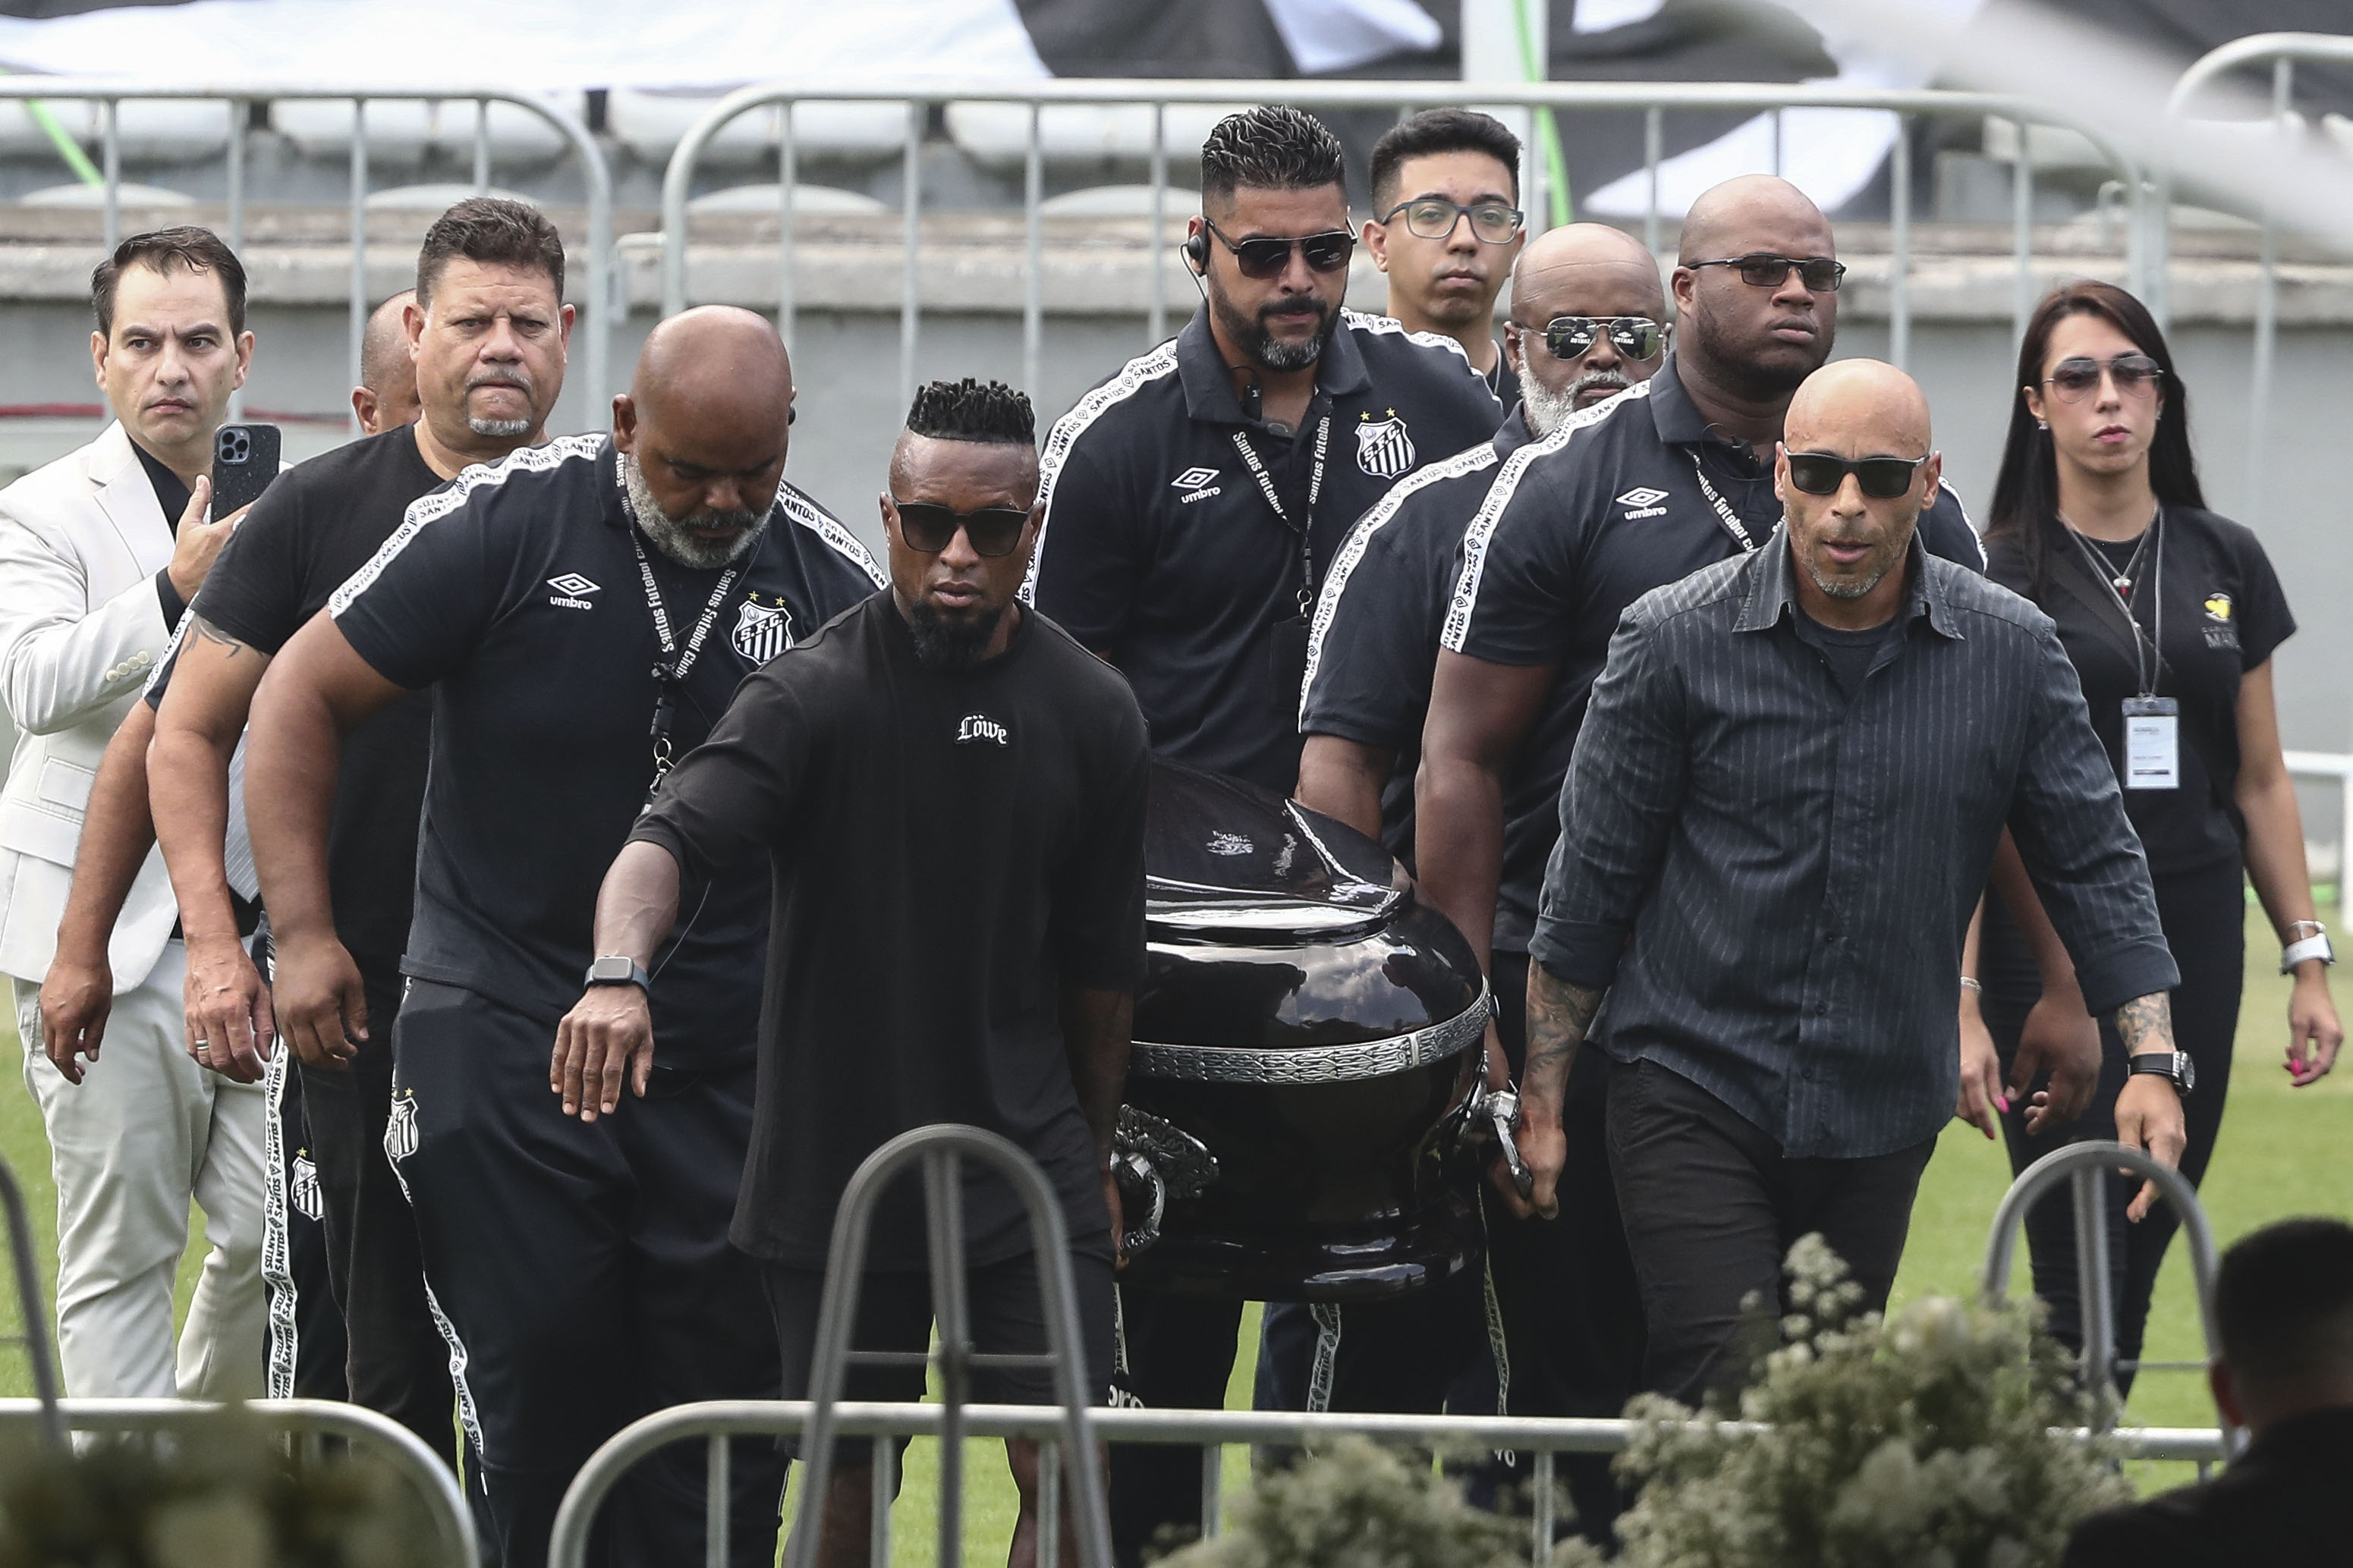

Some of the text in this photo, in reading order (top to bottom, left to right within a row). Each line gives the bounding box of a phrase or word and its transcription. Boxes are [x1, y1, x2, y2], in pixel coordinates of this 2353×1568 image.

[1055, 421, 1081, 458] SANTOS
[1090, 387, 1126, 413] SANTOS
[1134, 359, 1171, 379] SANTOS
[1232, 431, 1284, 515] Santos Futebol
[1308, 460, 1324, 504] Santos
[1181, 486, 1221, 504] umbro
[1625, 506, 1667, 520] umbro
[1476, 498, 1501, 538] SANTOS
[1713, 497, 1748, 539] Futebol
[824, 529, 862, 558] SANTOS
[1314, 602, 1333, 643] SANTOS
[1362, 501, 1394, 533] SANTOS
[1455, 451, 1494, 472] SANTOS
[549, 595, 593, 611] umbro
[639, 562, 662, 608] Futebol
[707, 569, 738, 608] Santos
[653, 608, 675, 652] Santos
[957, 715, 1007, 744] Löwe
[269, 1067, 282, 1108] SANTOS
[272, 1121, 282, 1163] SANTOS
[266, 1228, 275, 1269] SANTOS
[275, 1230, 285, 1272] SANTOS
[282, 1327, 294, 1365] SANTOS
[455, 1375, 470, 1416] SANTOS
